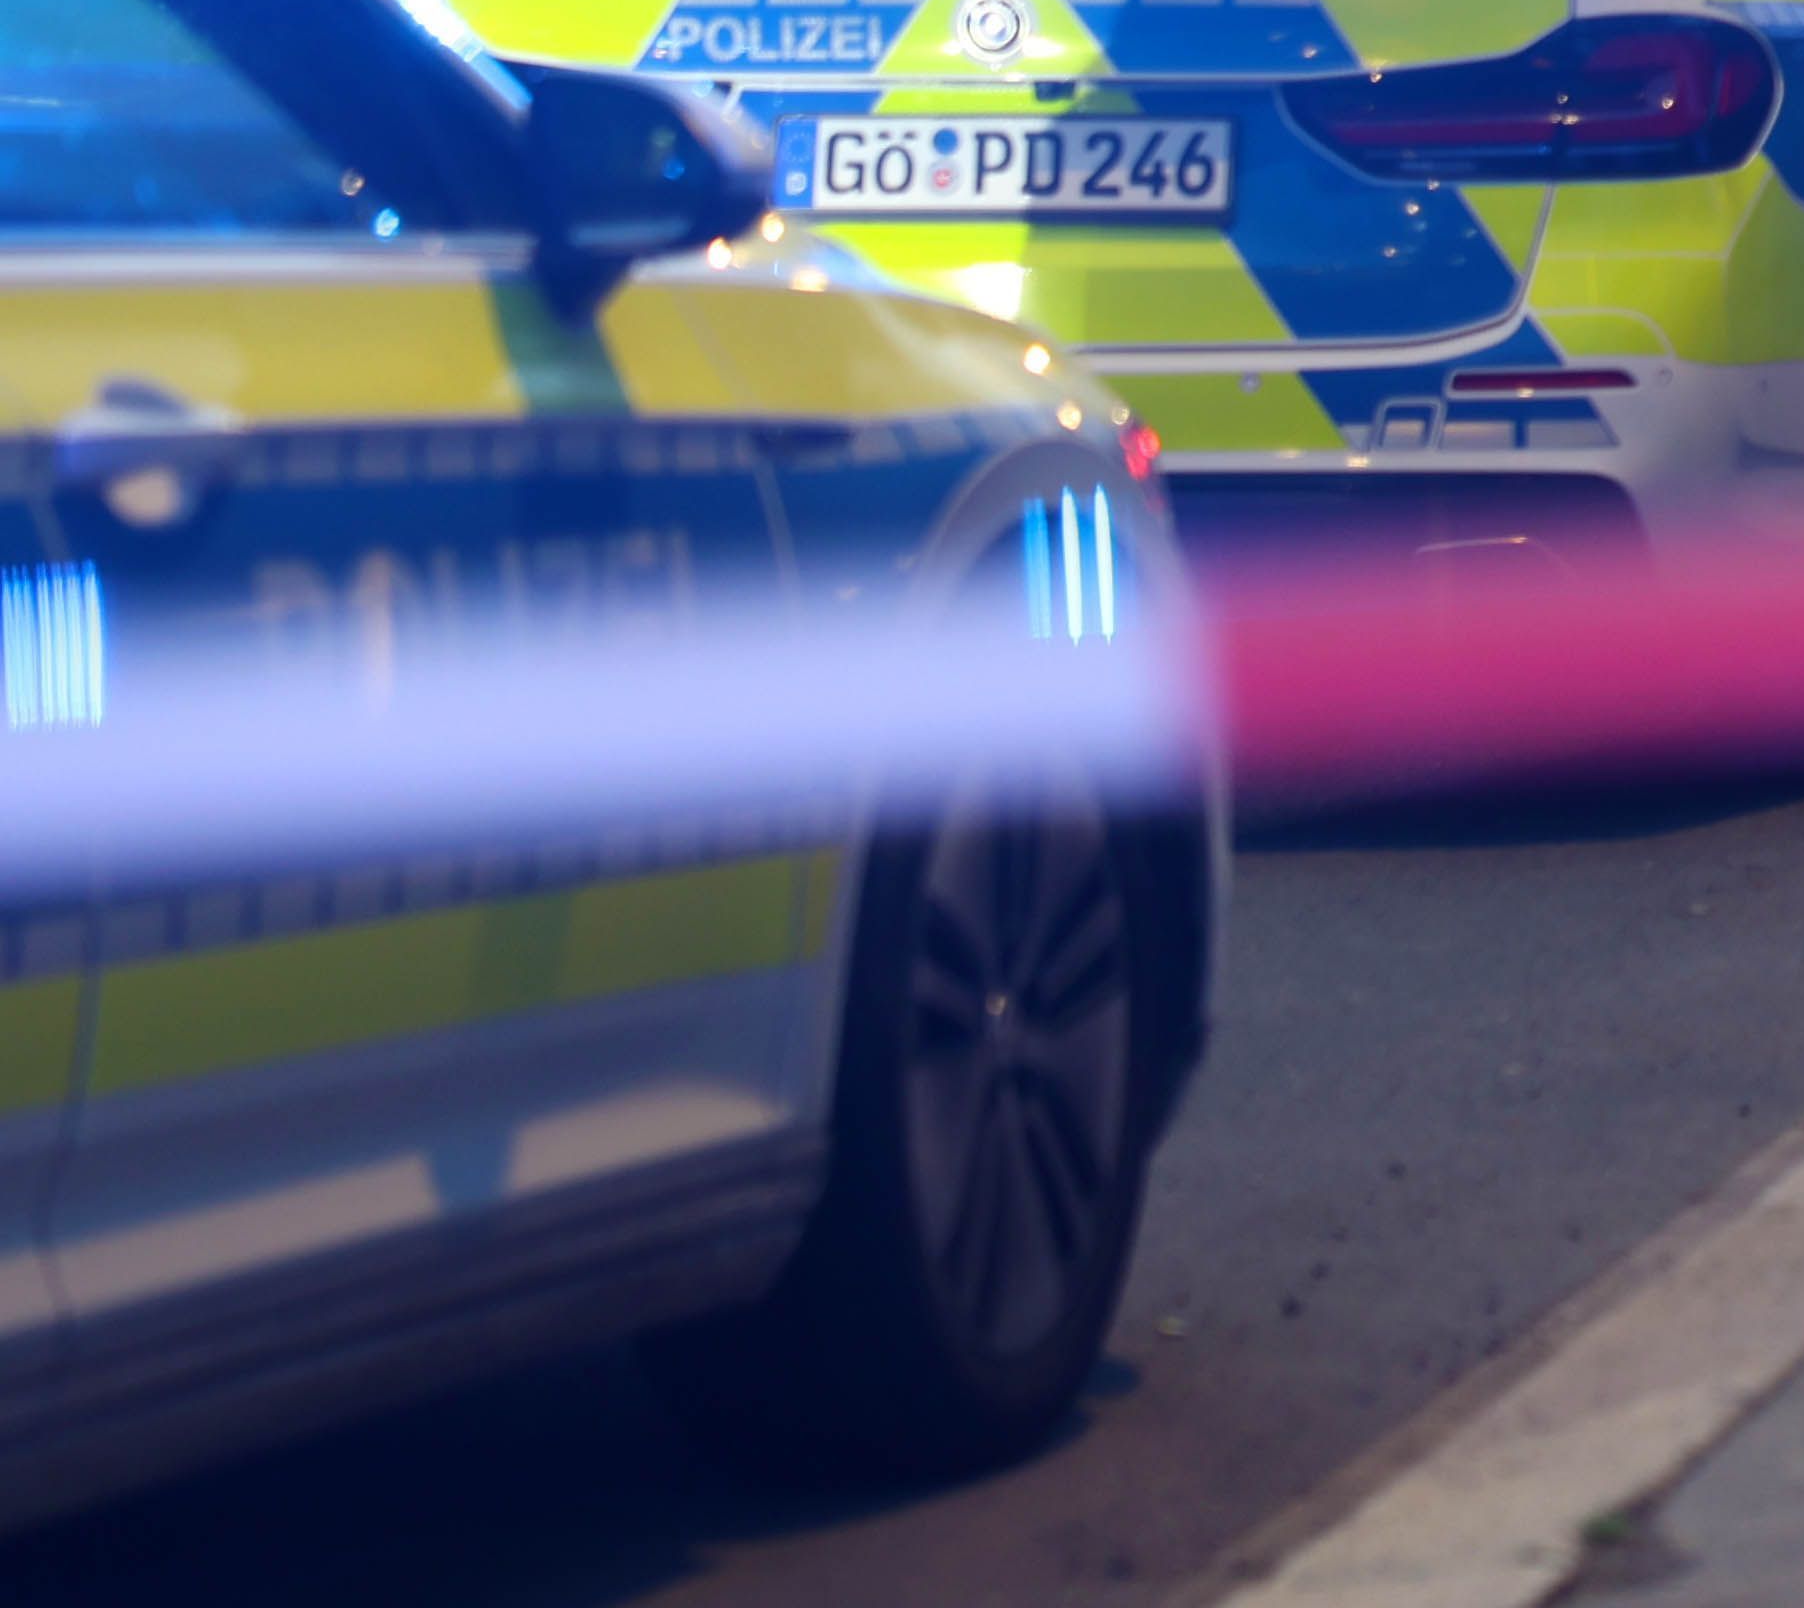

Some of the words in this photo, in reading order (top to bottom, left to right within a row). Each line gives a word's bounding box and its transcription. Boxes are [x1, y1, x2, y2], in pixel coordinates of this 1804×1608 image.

[664, 15, 882, 62] POLIZEI
[825, 129, 914, 195] GÖ
[974, 129, 1063, 196] PD
[1081, 128, 1216, 198] 246
